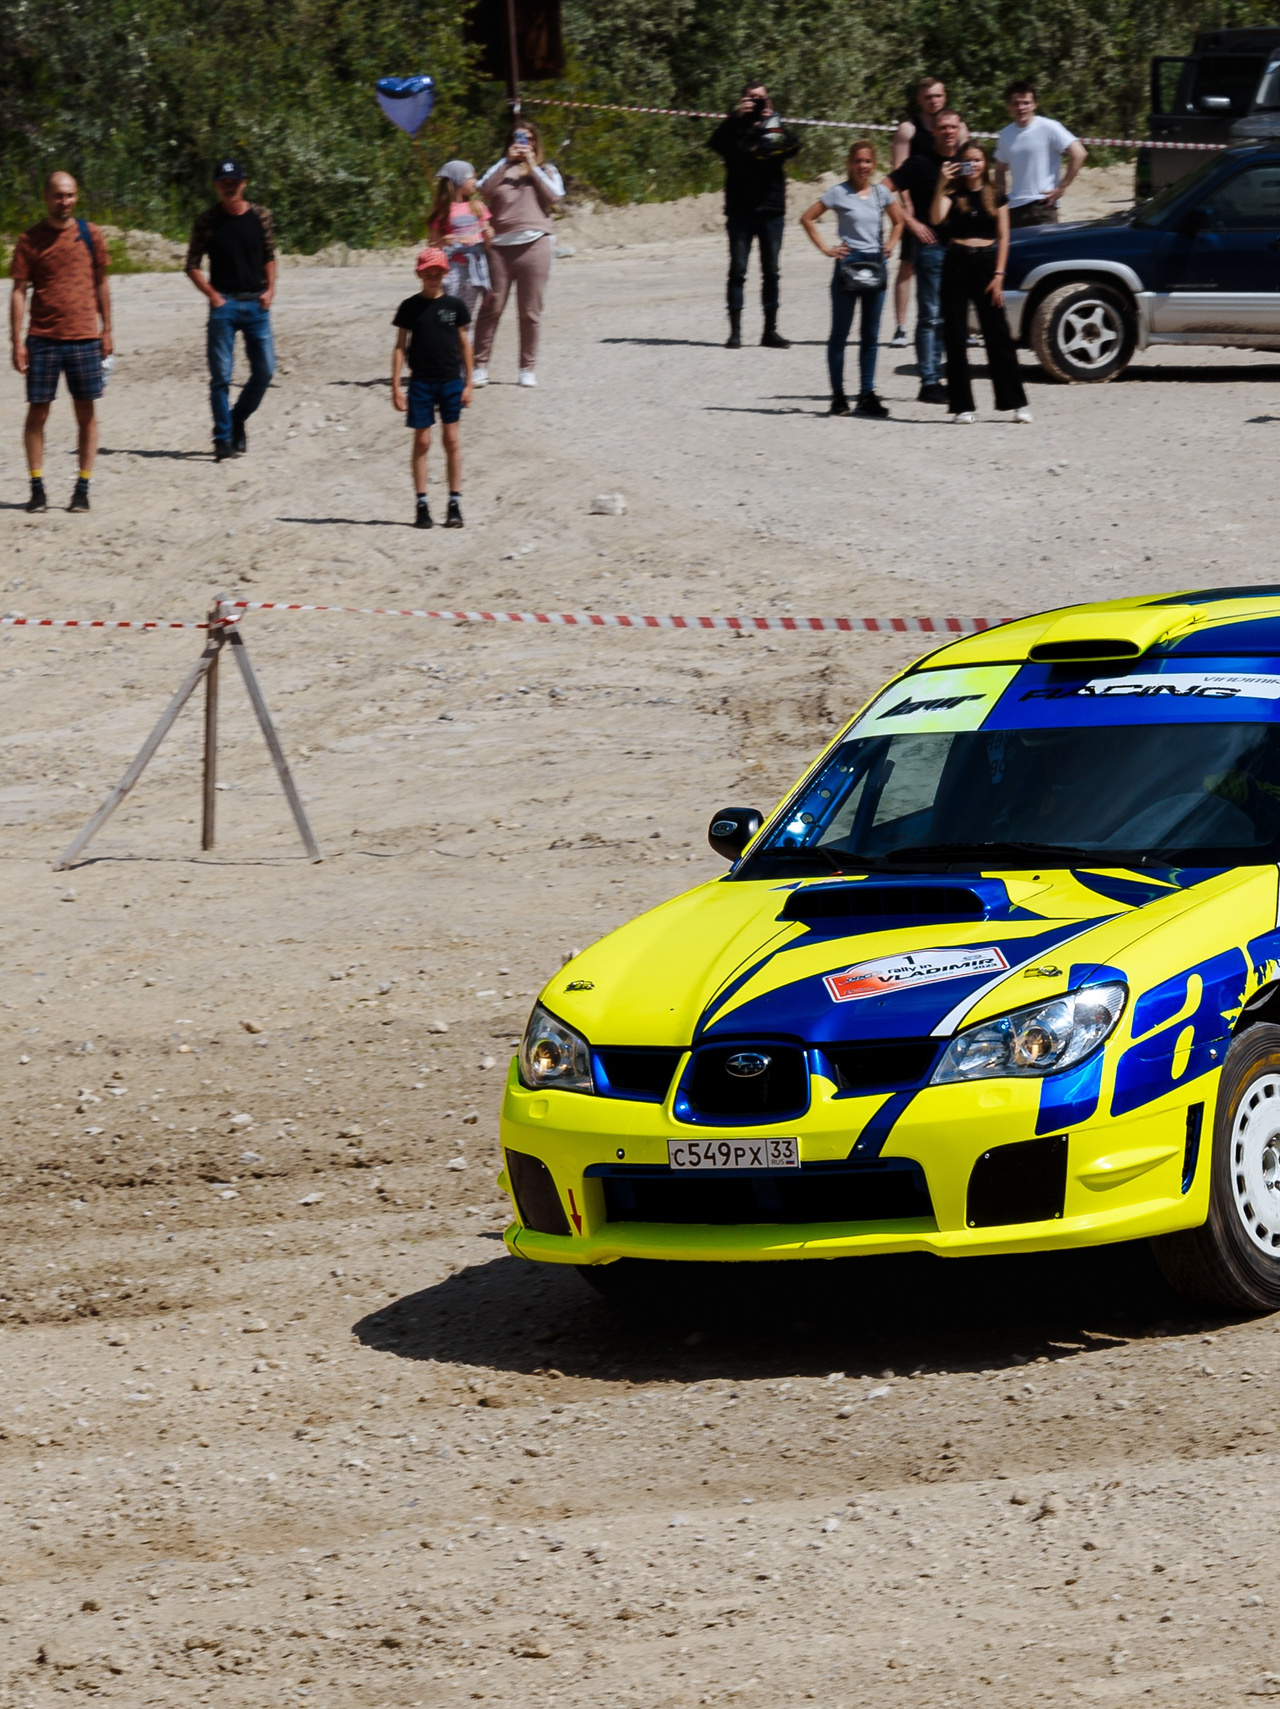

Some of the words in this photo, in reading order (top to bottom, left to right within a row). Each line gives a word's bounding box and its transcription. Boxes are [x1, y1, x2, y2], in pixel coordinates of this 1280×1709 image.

[902, 955, 915, 965] 1
[878, 958, 994, 983] VLADIMIR
[887, 966, 916, 974] rally
[770, 1140, 793, 1159] 33
